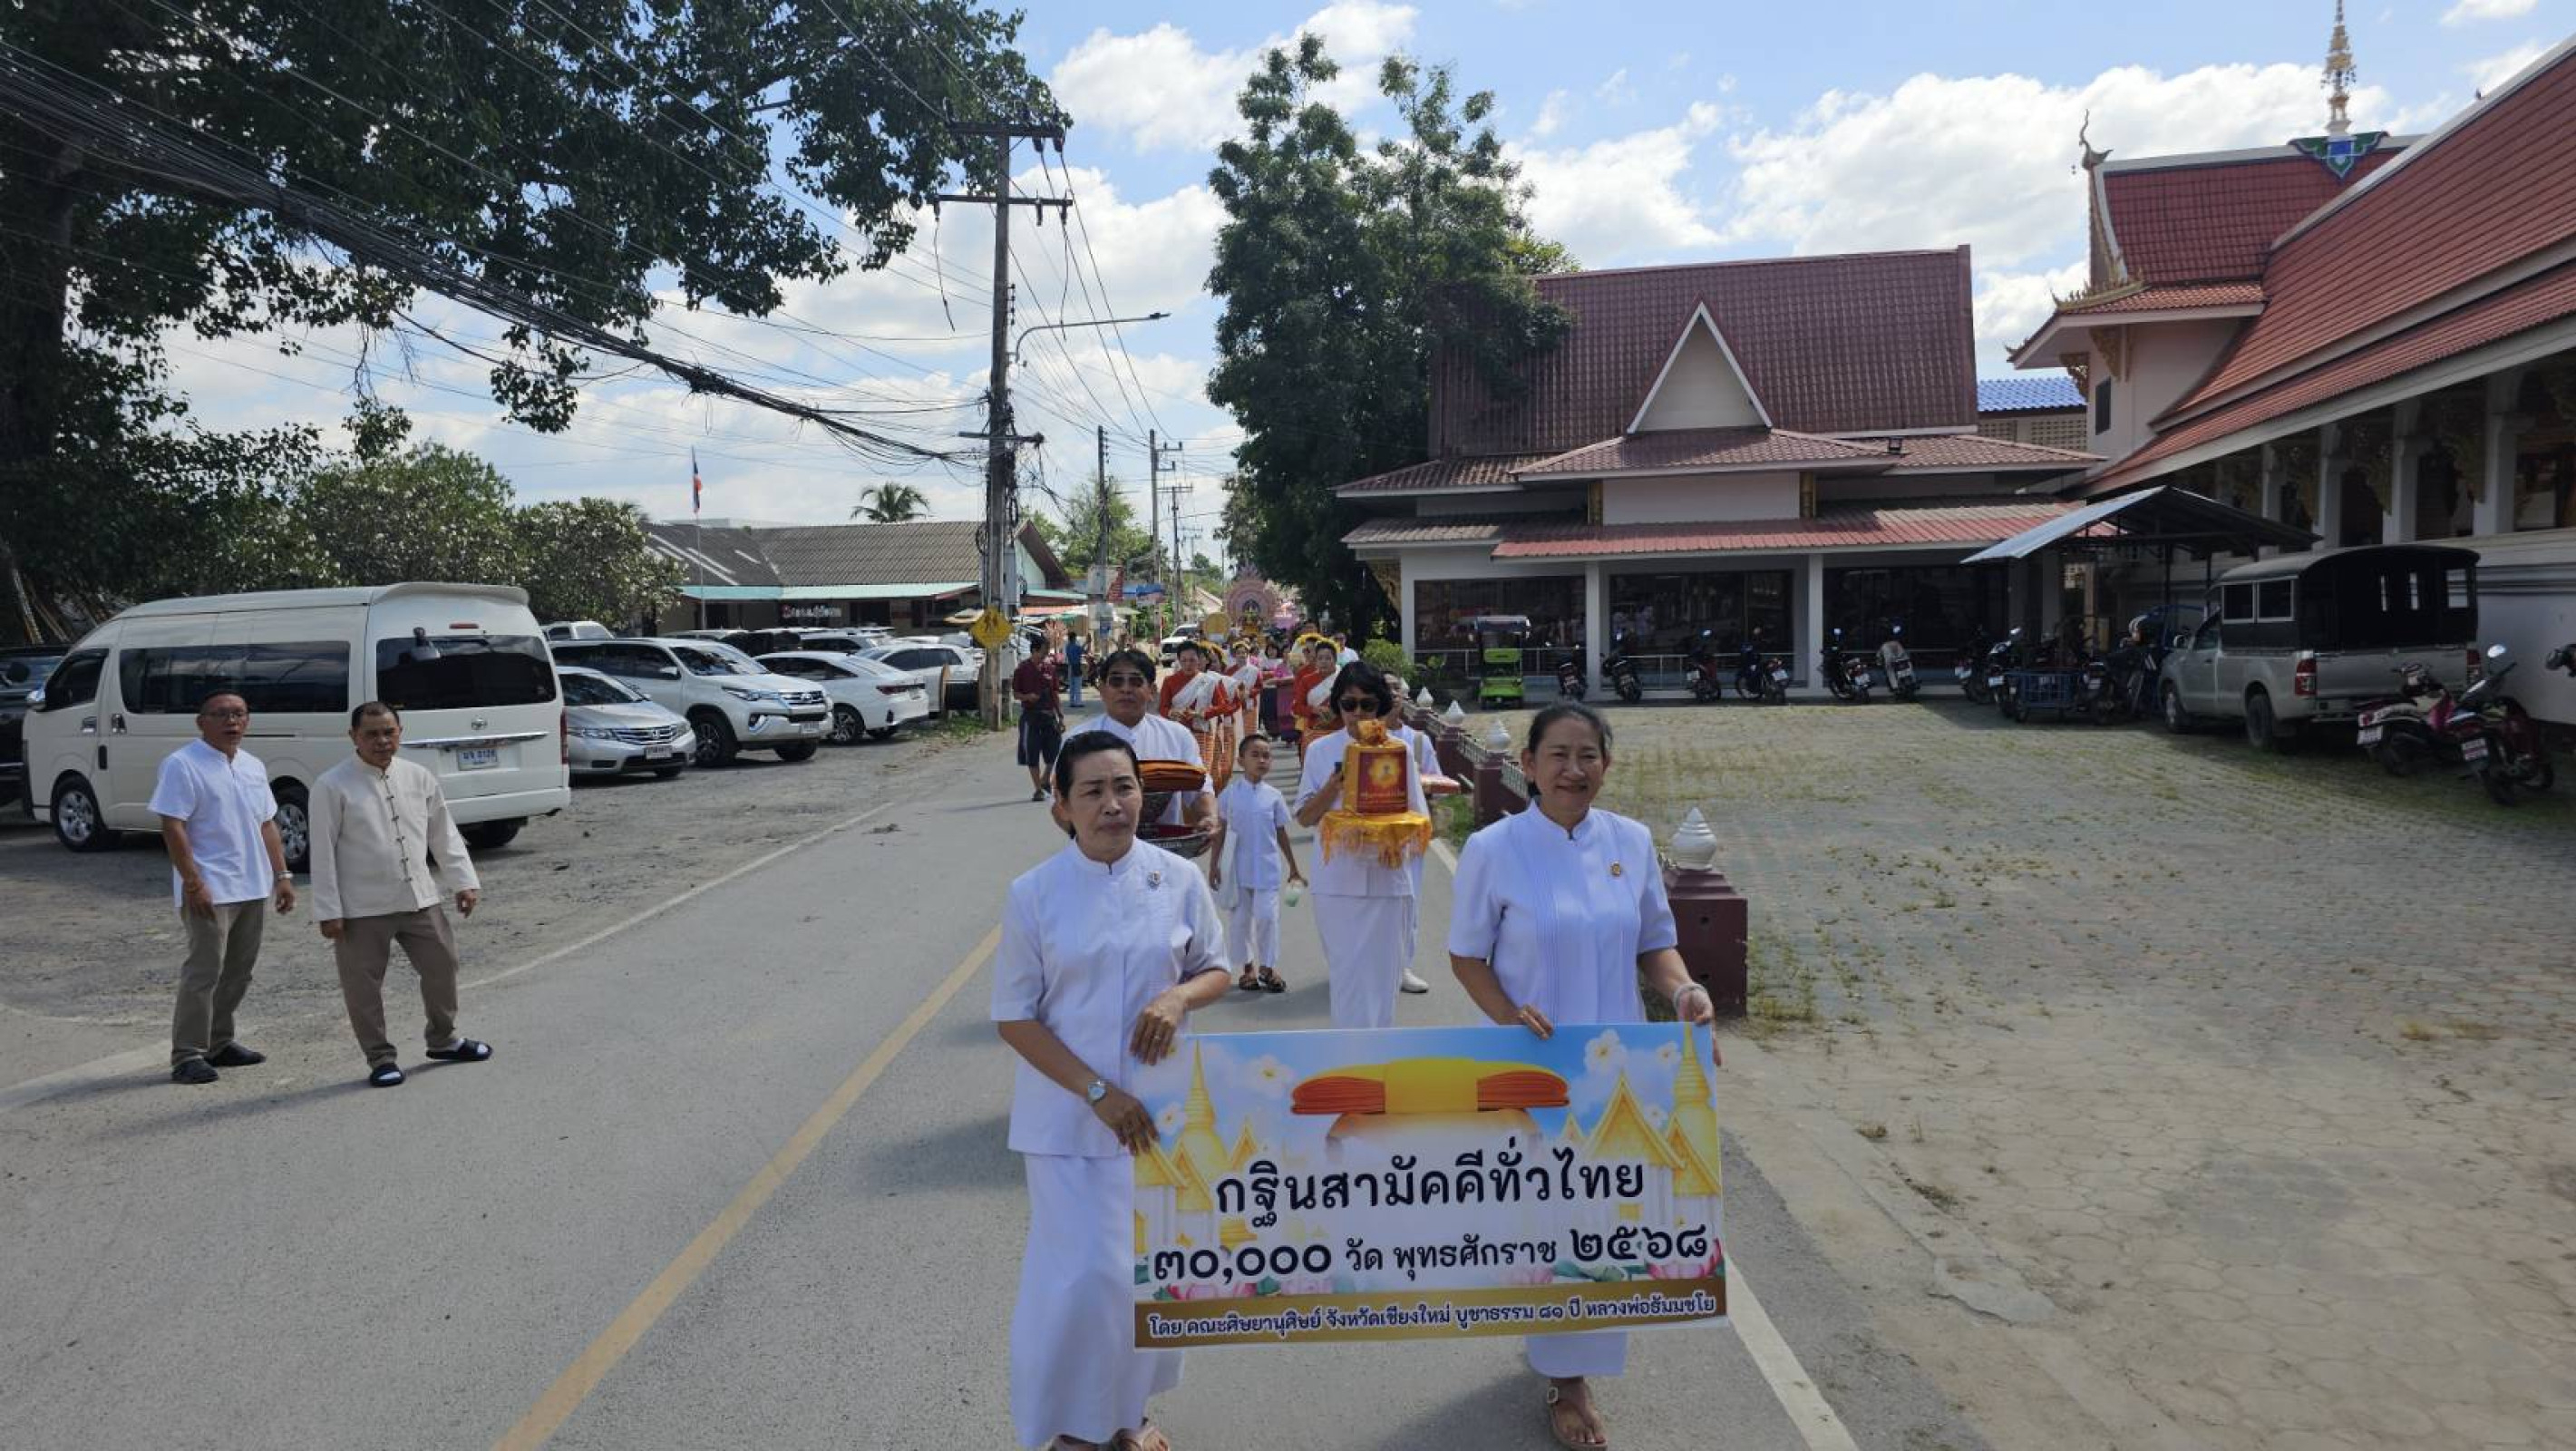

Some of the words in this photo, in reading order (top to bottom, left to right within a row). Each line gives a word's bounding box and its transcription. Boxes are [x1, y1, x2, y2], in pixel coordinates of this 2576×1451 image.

[1217, 1136, 1643, 1227] กฐินสามัคคีทั่วไทย
[1154, 1245, 1331, 1284] ๓๐,๐๐๐
[1346, 1238, 1383, 1271] วัด
[1394, 1233, 1557, 1281] พุทธศักราช
[1570, 1224, 1708, 1261] ๒๕๖๘
[1150, 1316, 1181, 1336] โดย
[1188, 1309, 1321, 1337] คณะศิษยานุศิษย์
[1327, 1303, 1450, 1328] จังหวัดเชียงใหม่
[1455, 1306, 1534, 1329] บูชาธรรม
[1569, 1297, 1581, 1318] ปี
